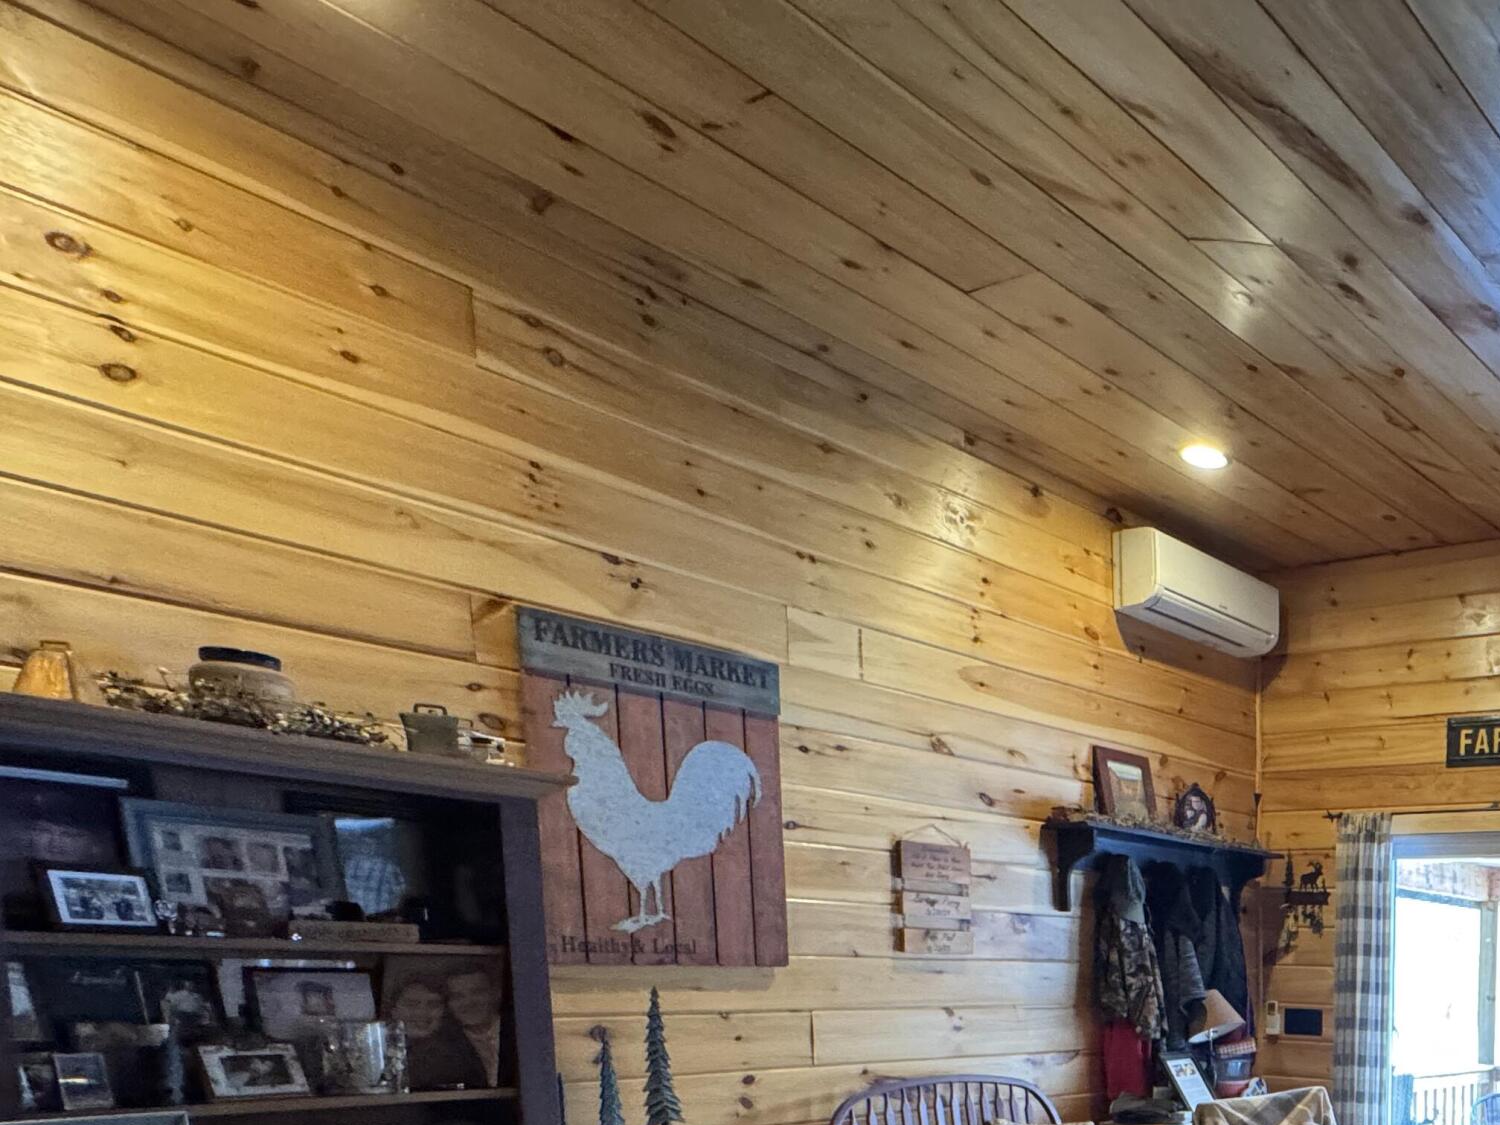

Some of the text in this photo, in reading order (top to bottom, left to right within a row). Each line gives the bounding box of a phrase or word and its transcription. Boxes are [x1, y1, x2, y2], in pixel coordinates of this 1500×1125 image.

[533, 616, 768, 690] FARMERS MARKET
[610, 662, 714, 696] FRESH EGGS
[654, 938, 696, 954] Local
